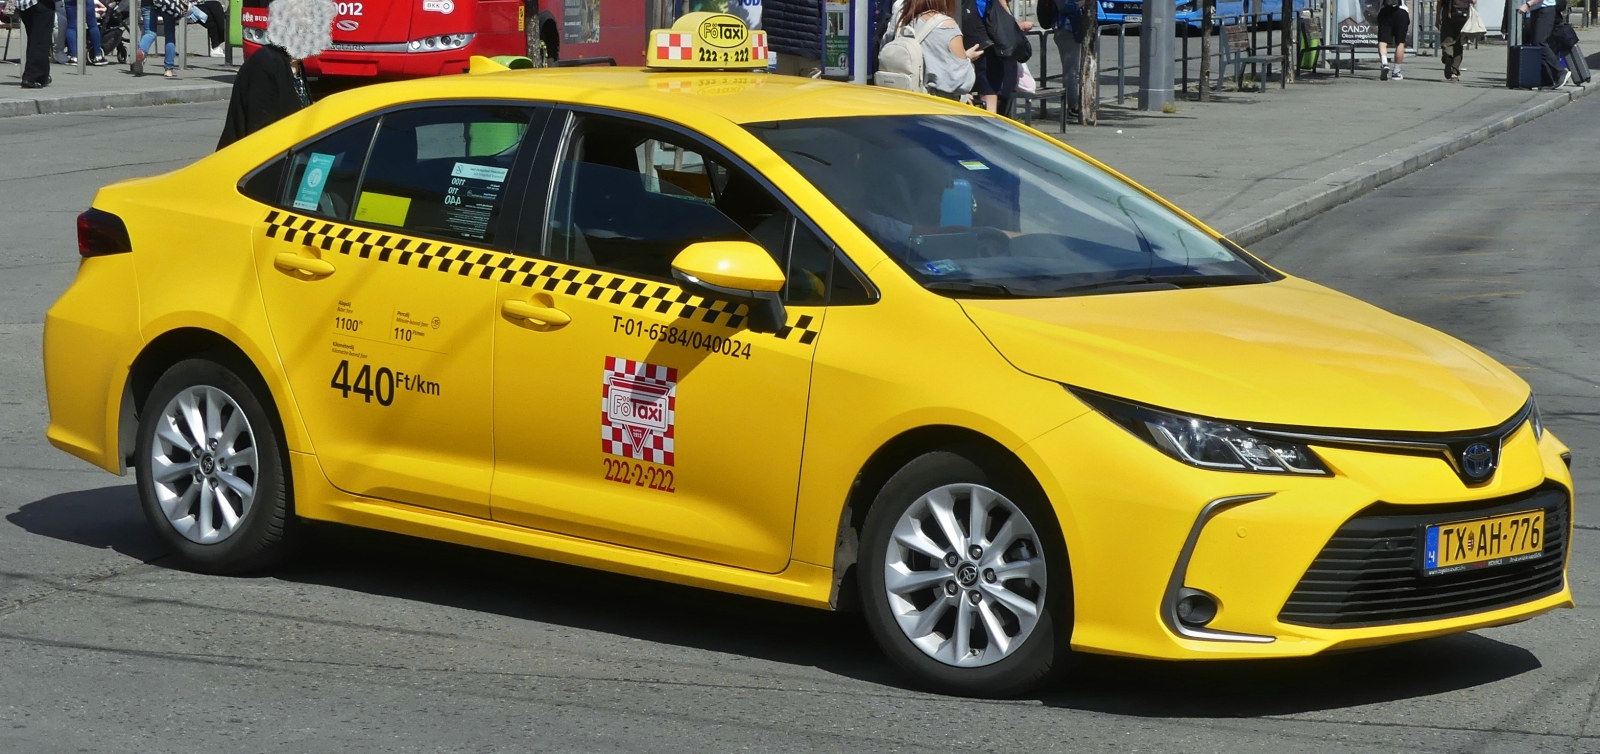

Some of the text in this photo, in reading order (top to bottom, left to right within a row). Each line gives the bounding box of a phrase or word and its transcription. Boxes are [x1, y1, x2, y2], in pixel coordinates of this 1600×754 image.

[336, 317, 358, 331] 1100
[395, 328, 412, 341] 110
[613, 316, 752, 360] T-01-6584/040024
[331, 360, 440, 406] 440 Ft/km
[1443, 527, 1467, 562] TX
